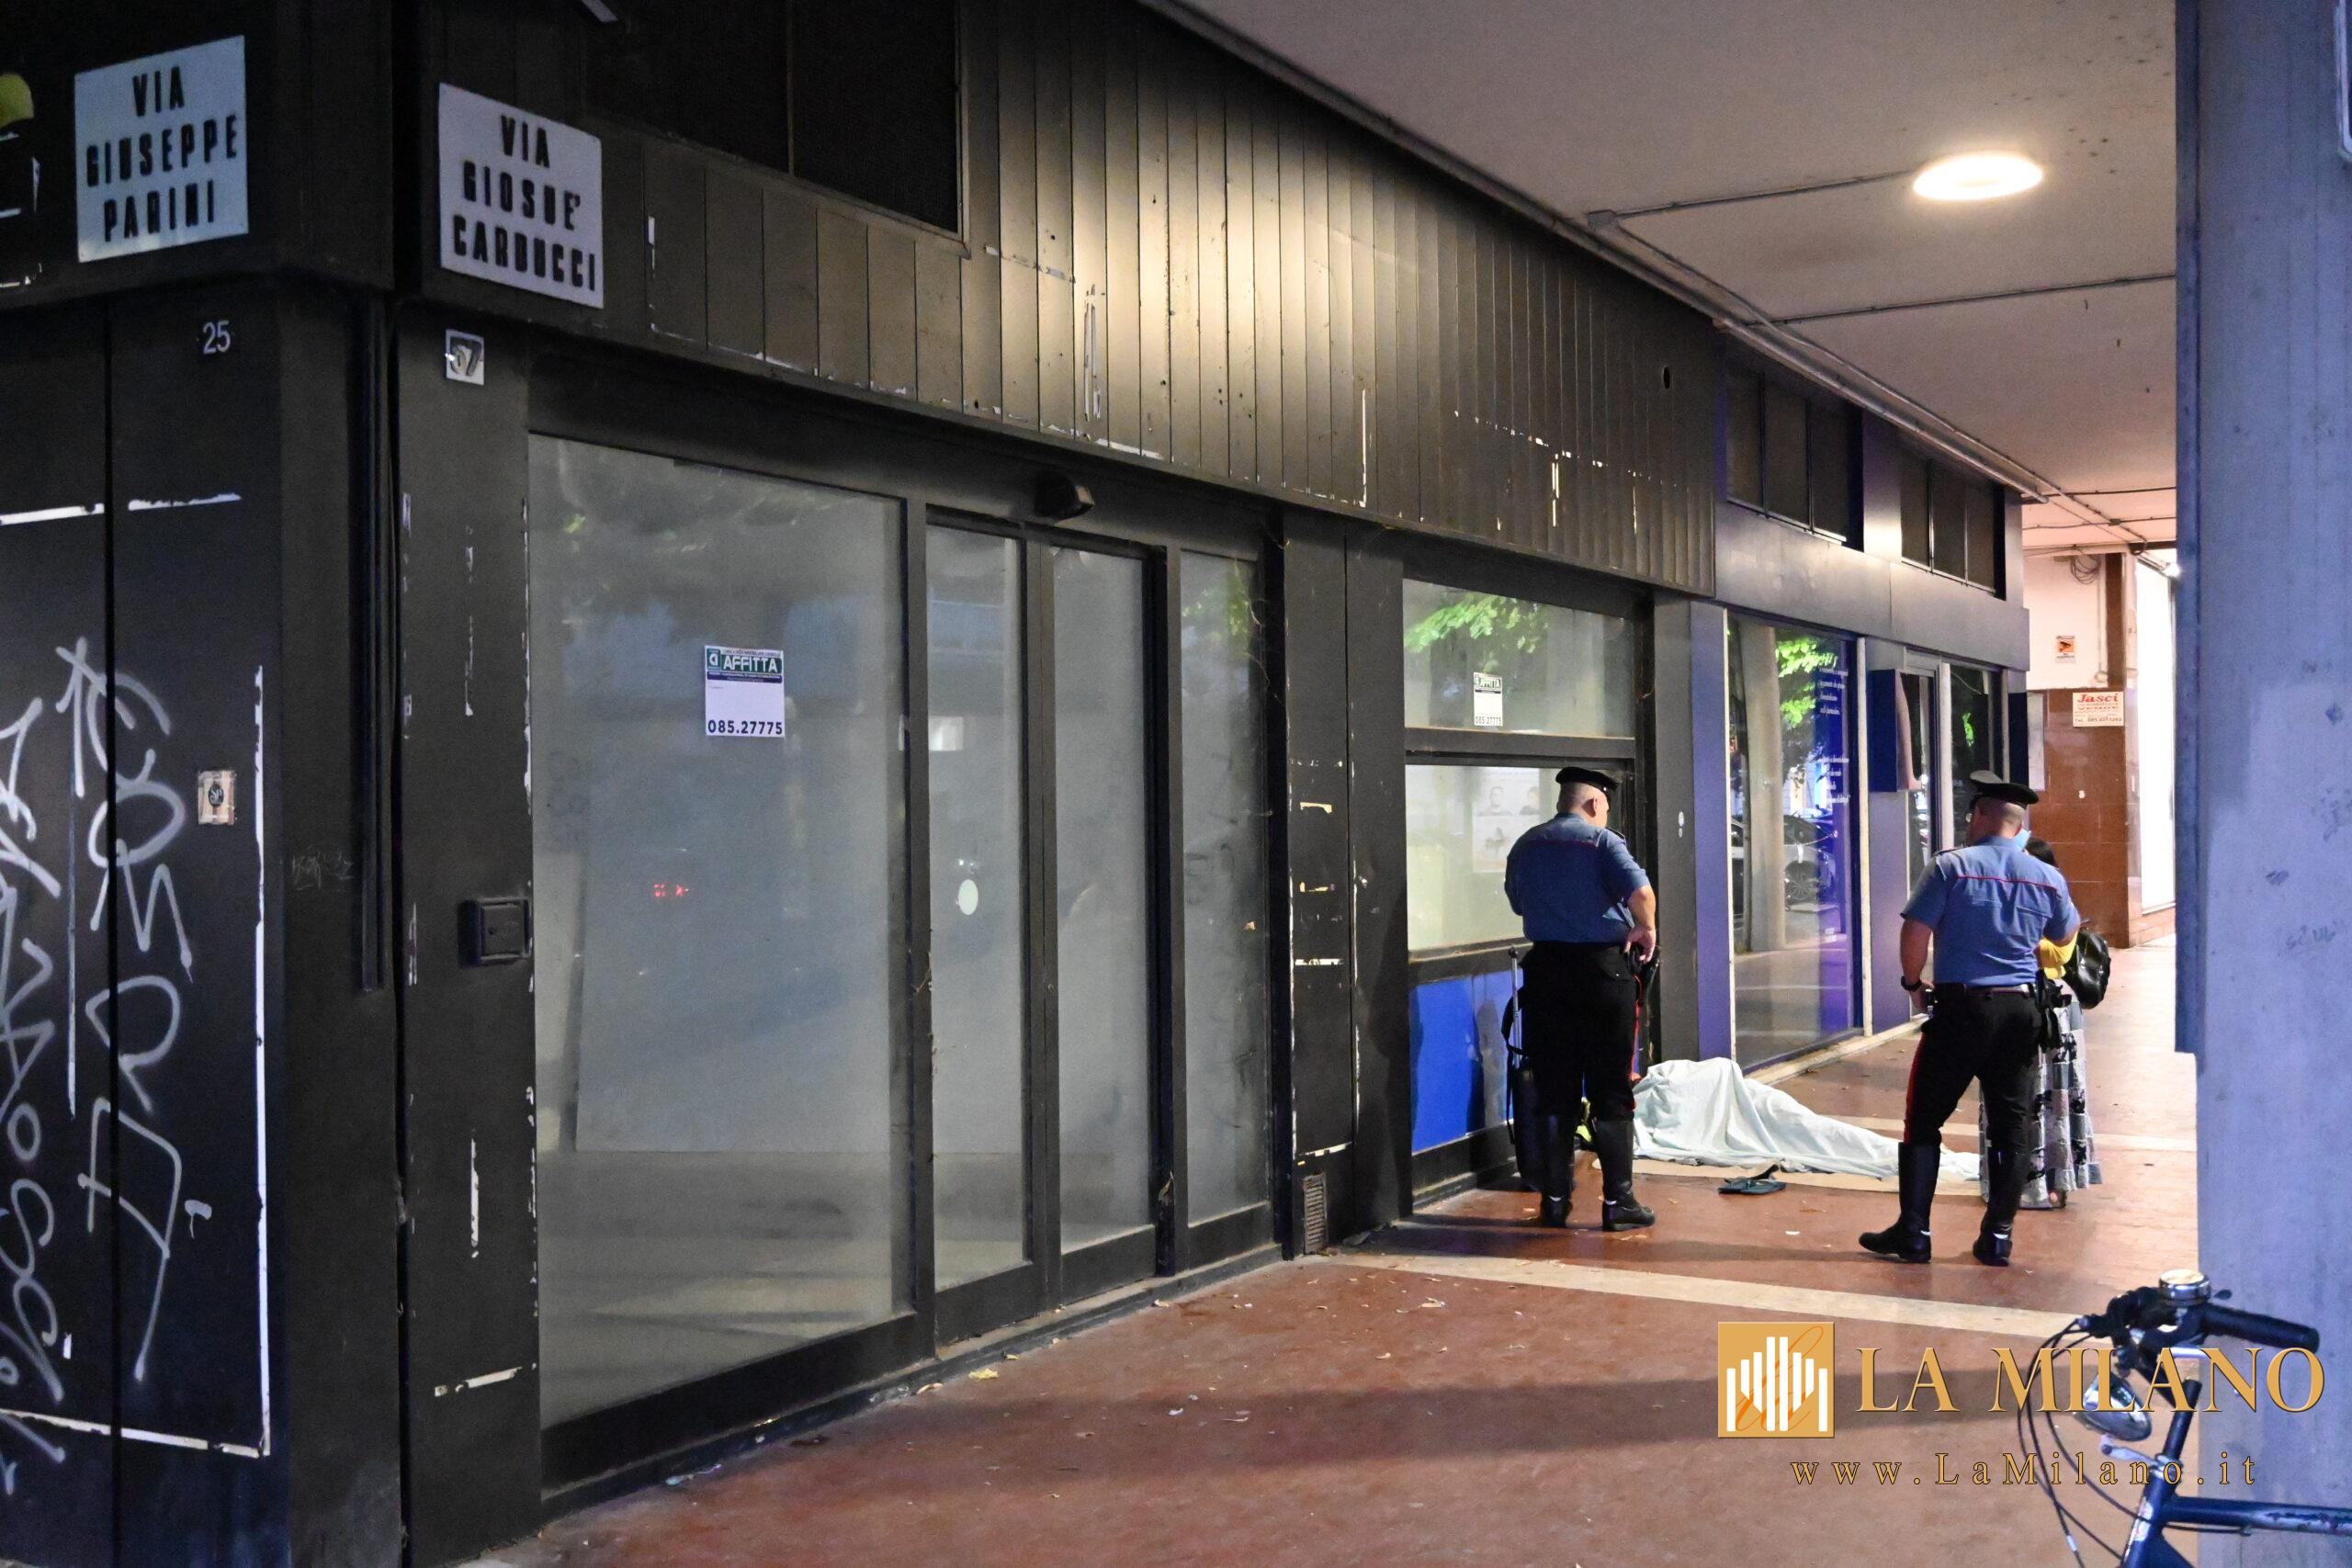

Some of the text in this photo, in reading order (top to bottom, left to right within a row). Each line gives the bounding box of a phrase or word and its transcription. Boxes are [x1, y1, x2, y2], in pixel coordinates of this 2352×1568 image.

[132, 66, 184, 117] VIA
[86, 113, 237, 187] GIUSEPPE
[501, 114, 549, 168] VIA
[103, 178, 214, 243] PARINI
[453, 214, 595, 292] CARDUCCI
[202, 320, 231, 355] 25
[723, 654, 778, 673] AFFITTA
[2076, 693, 2120, 703] Jasci
[707, 719, 783, 735] 085.27775
